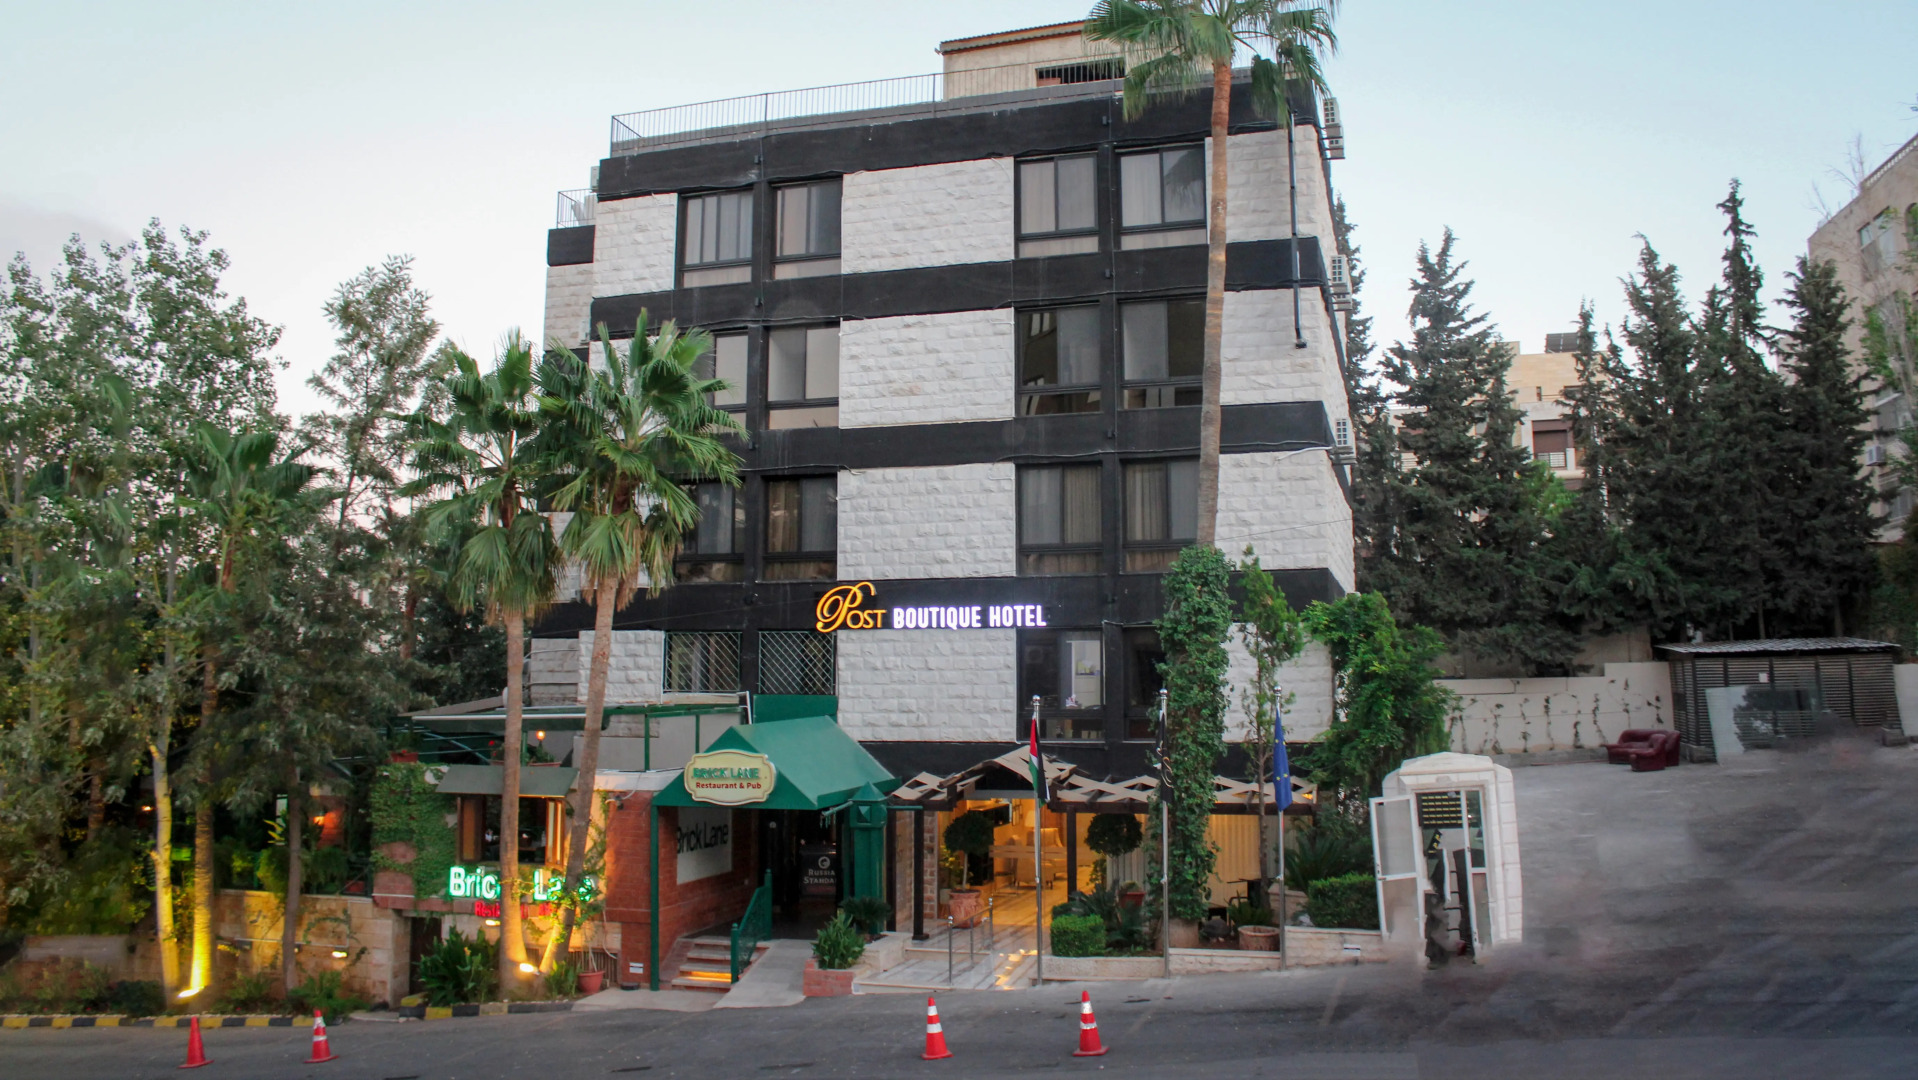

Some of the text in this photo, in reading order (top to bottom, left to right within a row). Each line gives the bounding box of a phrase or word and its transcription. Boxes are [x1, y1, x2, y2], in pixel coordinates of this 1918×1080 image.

[893, 606, 982, 630] BOUTIQUE
[989, 604, 1048, 628] HOTEL
[693, 768, 760, 779] BRICK LANE
[704, 821, 729, 848] Lane
[803, 876, 837, 884] STANDA
[808, 868, 836, 876] RUSSIA
[449, 866, 501, 900] Bric
